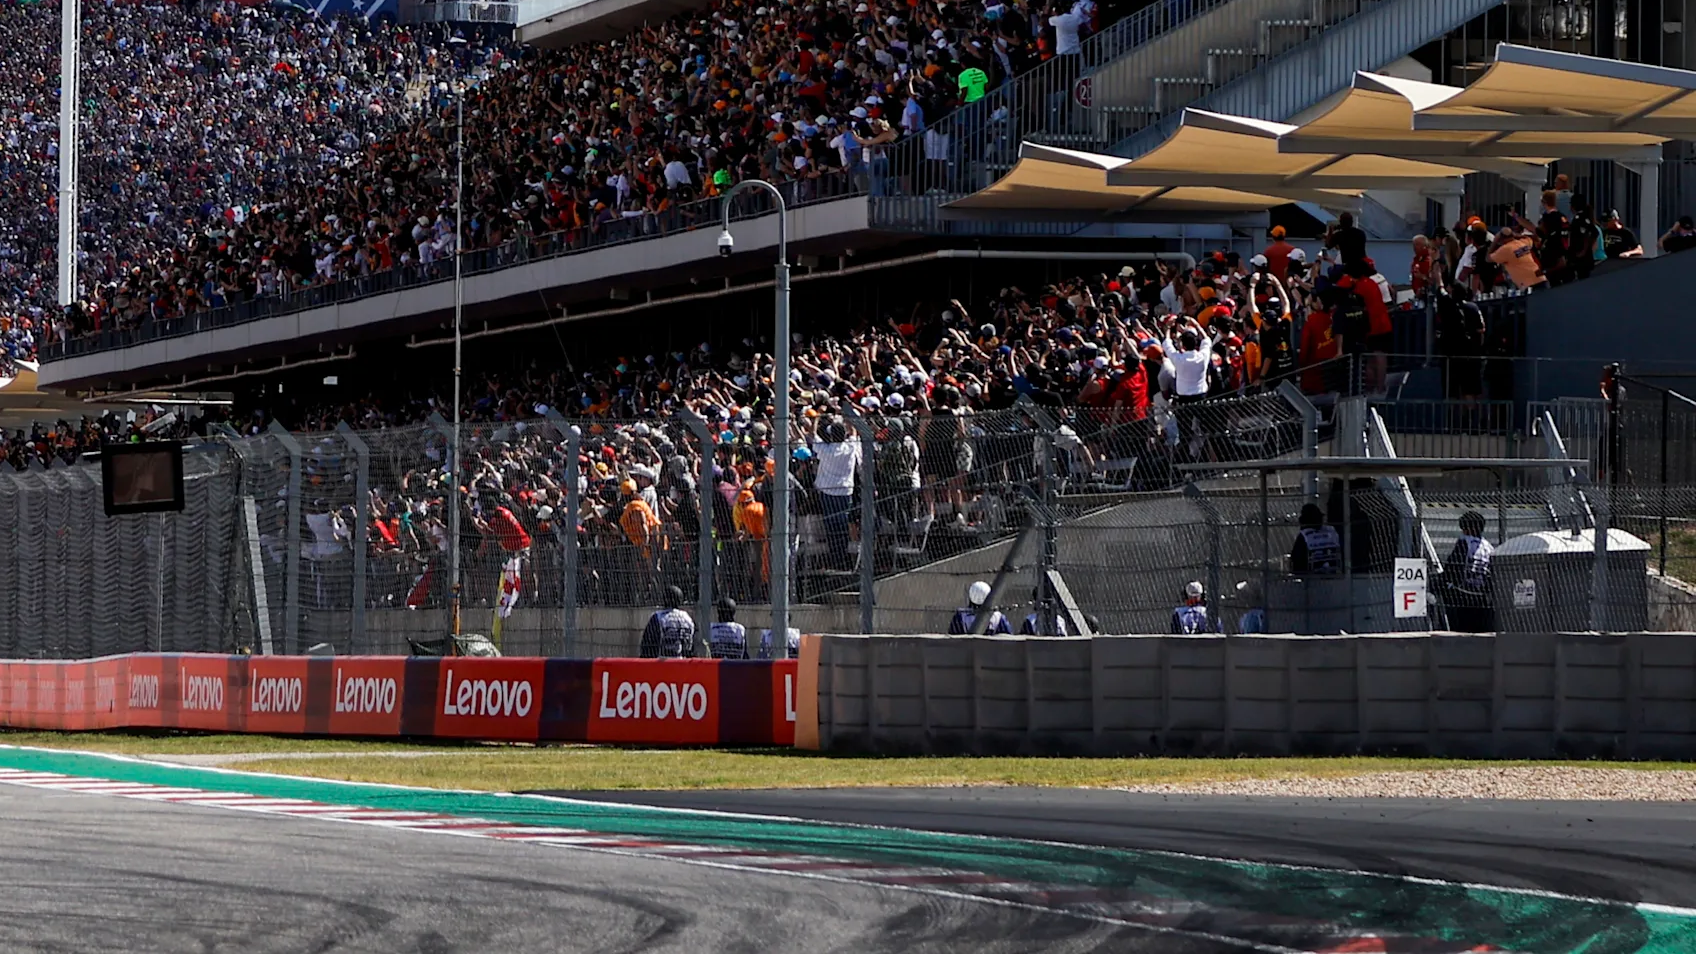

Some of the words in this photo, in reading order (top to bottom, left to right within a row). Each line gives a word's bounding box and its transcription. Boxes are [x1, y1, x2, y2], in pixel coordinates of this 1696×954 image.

[1396, 568, 1425, 581] 20A
[1403, 592, 1416, 610] F
[128, 666, 159, 708] Lenovo
[181, 667, 224, 711] Lenovo
[251, 668, 302, 713] Lenovo
[335, 667, 397, 714] Lenovo
[444, 668, 533, 717] Lenovo
[599, 671, 708, 721] Lenovo
